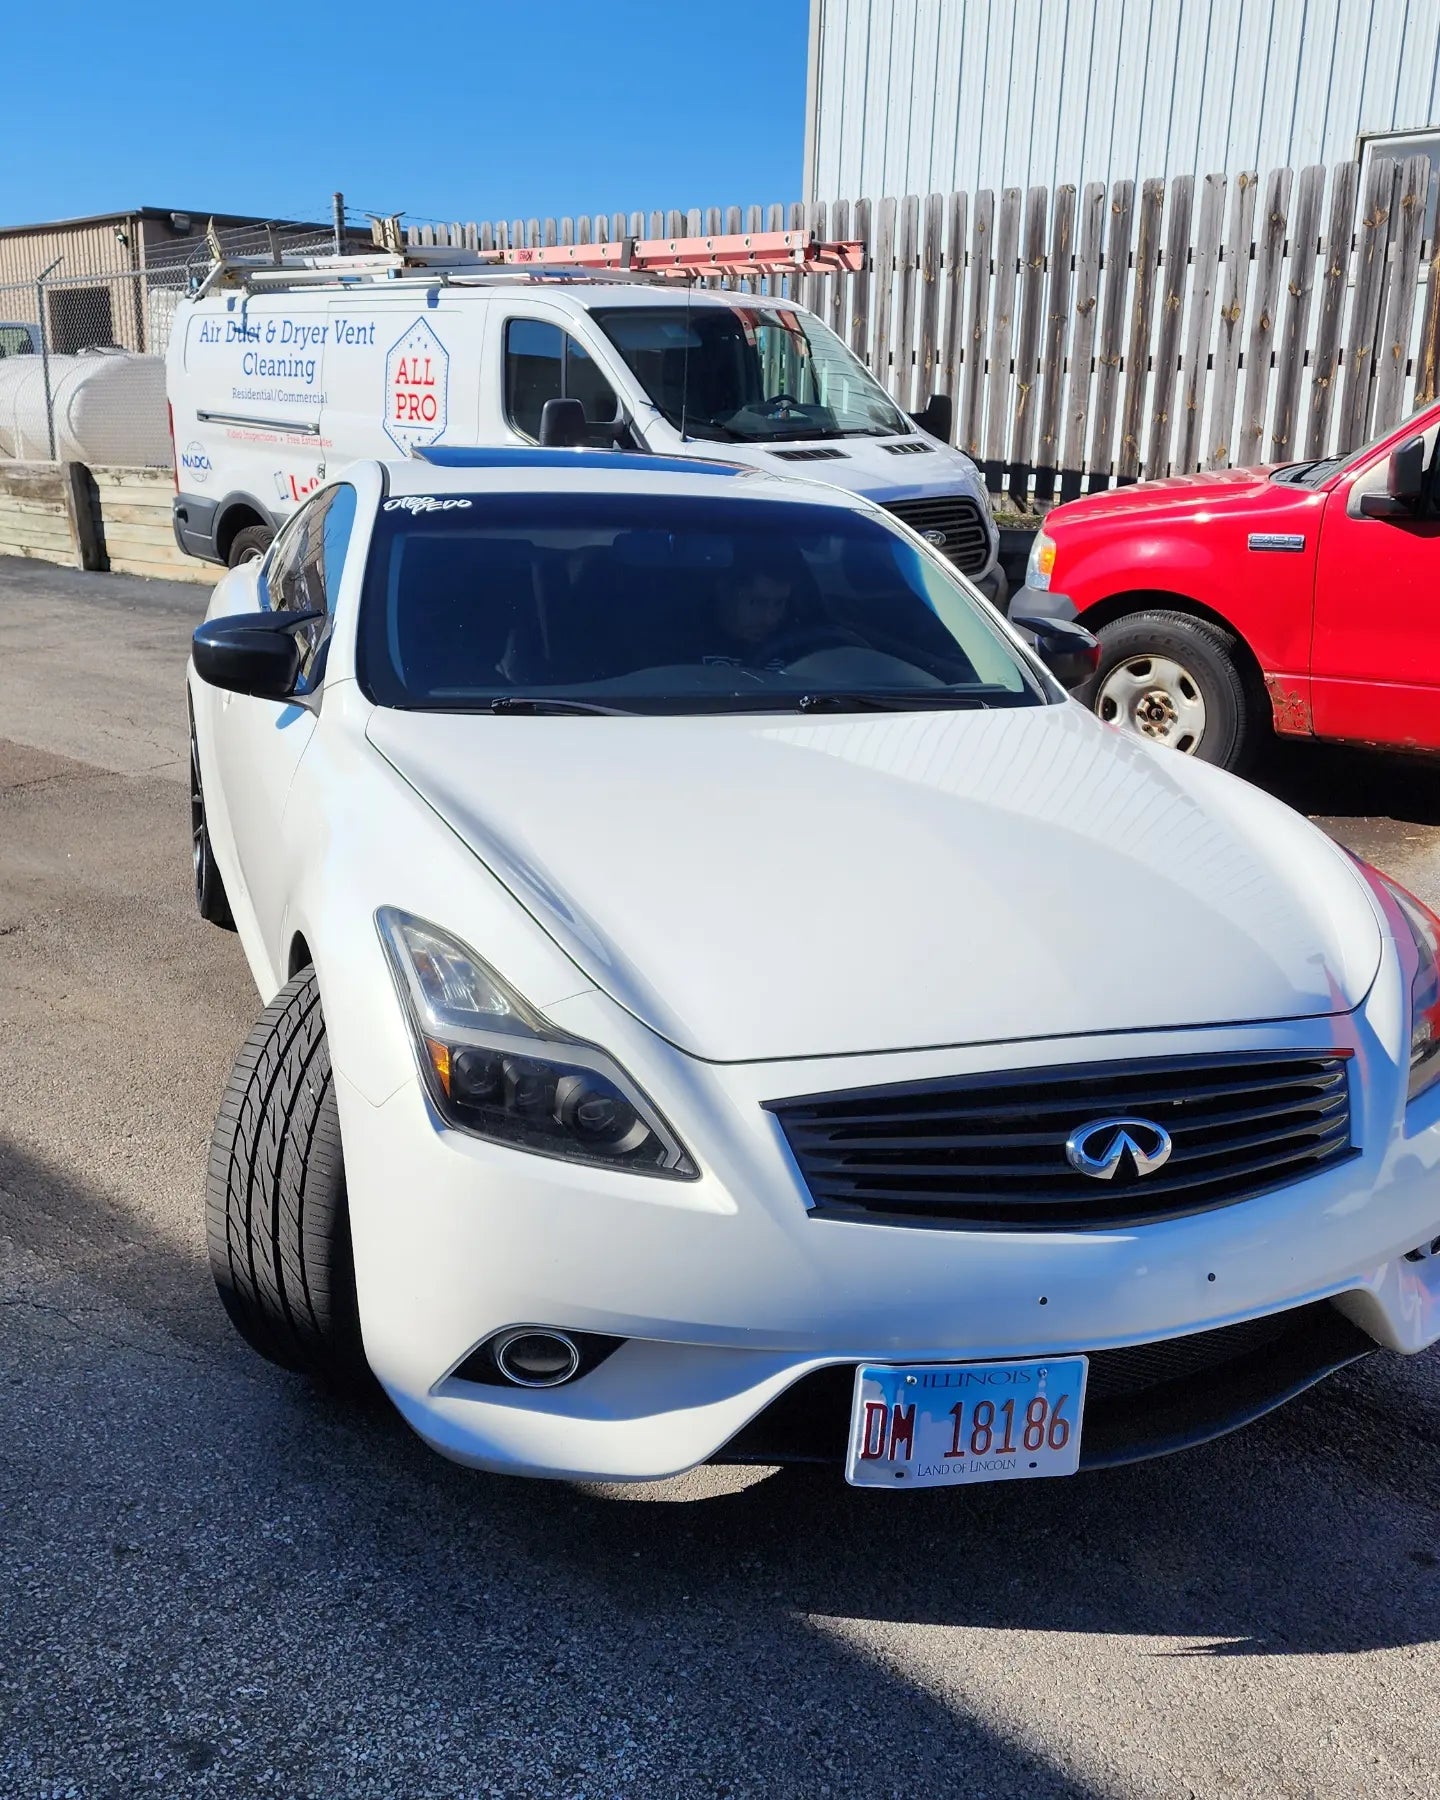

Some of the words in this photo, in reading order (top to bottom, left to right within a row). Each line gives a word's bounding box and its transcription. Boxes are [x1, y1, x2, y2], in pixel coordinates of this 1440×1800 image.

[199, 320, 222, 343] Air
[225, 320, 262, 343] Duct
[265, 319, 277, 344] &
[280, 320, 329, 351] Dryer
[334, 319, 376, 345] Vent
[242, 352, 316, 385] Cleaning
[395, 357, 435, 385] ALL
[231, 387, 328, 404] Residential/Commercial
[395, 393, 437, 422] PRO
[182, 452, 213, 471] NADCA
[922, 1368, 1032, 1388] ILLINOIS
[860, 1402, 917, 1461] DM
[943, 1394, 1070, 1459] 18186
[917, 1463, 950, 1478] LAND
[952, 1462, 968, 1475] OF
[969, 1458, 1017, 1474] LINCOLN
